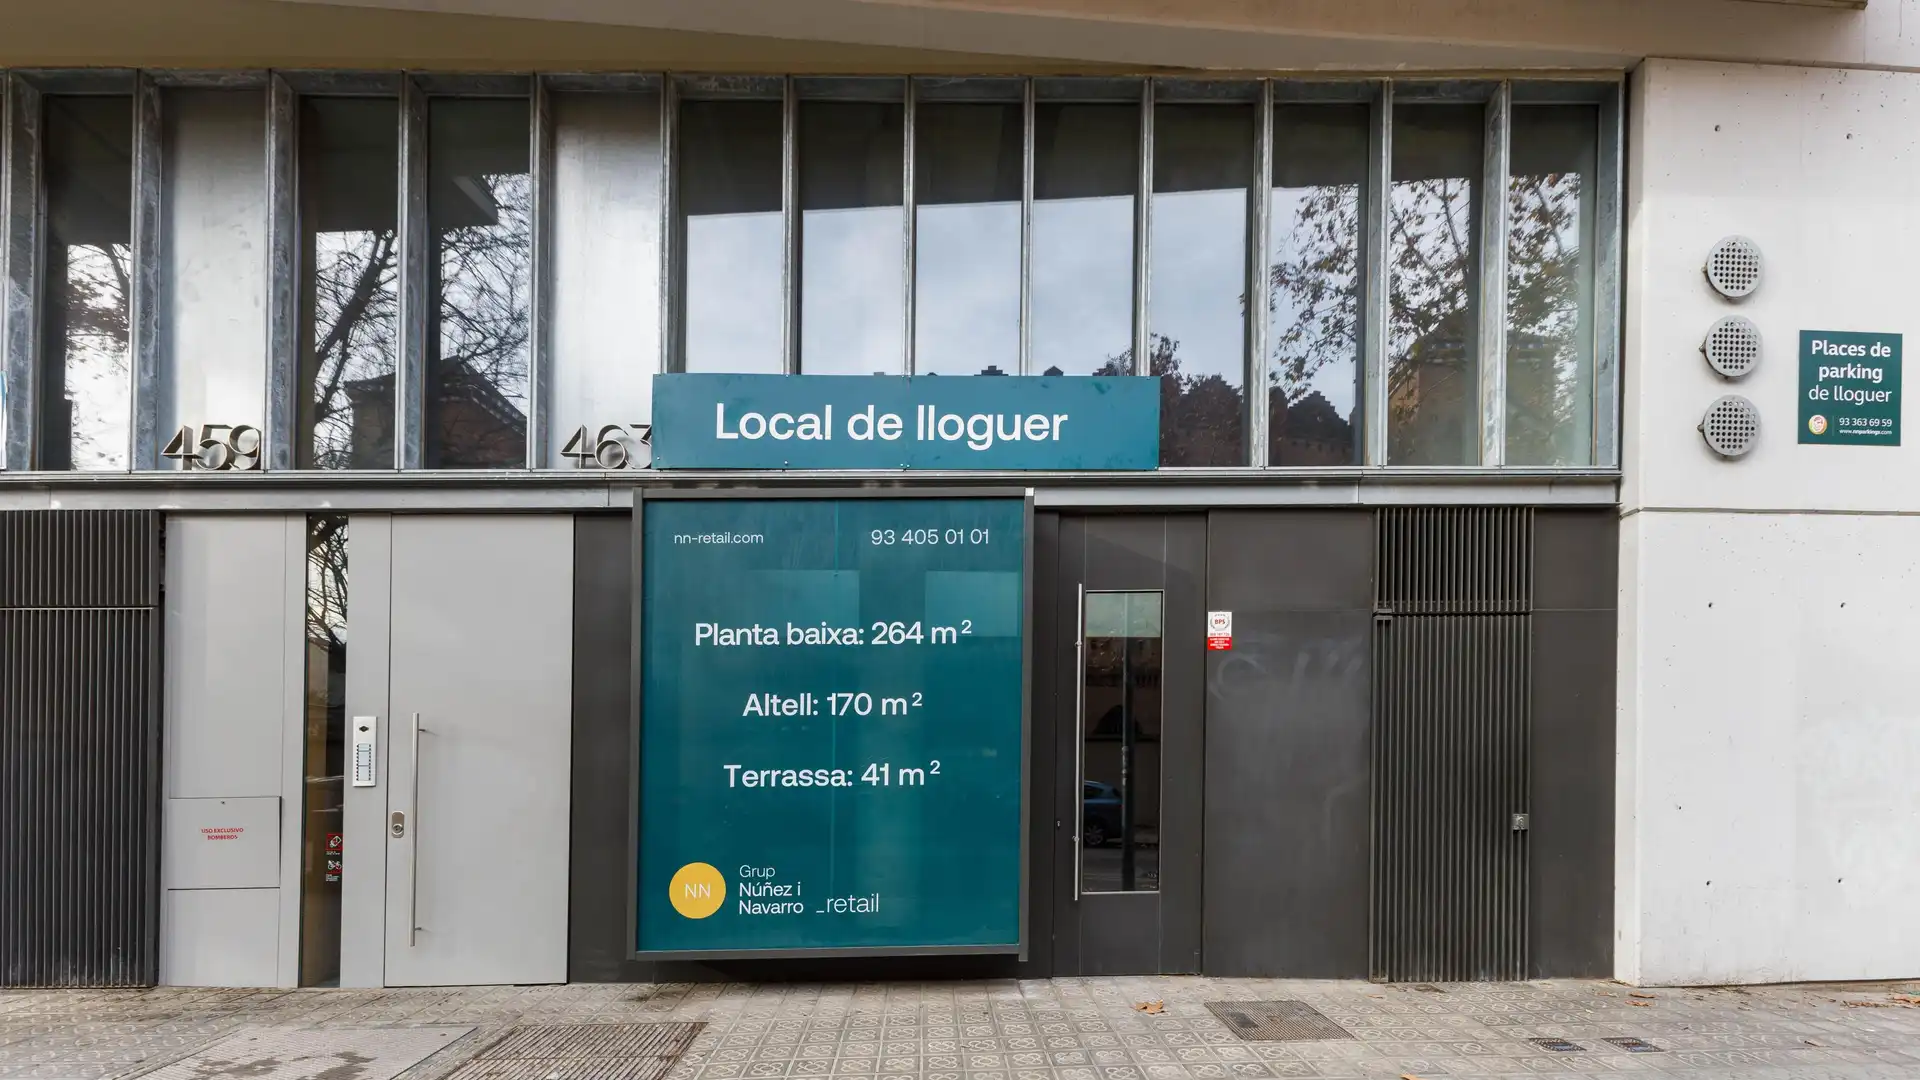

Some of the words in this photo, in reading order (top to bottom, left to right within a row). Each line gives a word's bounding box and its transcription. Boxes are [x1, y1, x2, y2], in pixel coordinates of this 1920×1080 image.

[1811, 339, 1867, 357] Places
[1870, 341, 1892, 358] de
[1818, 362, 1883, 384] parking
[1808, 384, 1830, 401] de
[1833, 385, 1893, 406] lloguer
[715, 402, 833, 441] Local
[847, 404, 904, 441] de
[916, 404, 1069, 452] lloguer
[1838, 418, 1850, 426] 93
[1852, 418, 1868, 426] 363
[1869, 418, 1880, 427] 69
[1881, 418, 1892, 428] 59
[161, 424, 261, 470] 459
[674, 530, 764, 545] nn-retail.com
[870, 529, 896, 546] 93
[901, 528, 939, 545] 405
[944, 528, 964, 545] 01
[969, 528, 989, 545] 01
[695, 622, 780, 647] Planta
[786, 620, 865, 646] baixa:
[871, 620, 925, 645] 264
[741, 692, 819, 717] Altell:
[826, 692, 873, 717] 170
[722, 764, 854, 789] Terrassa:
[860, 762, 890, 787] 41
[739, 864, 776, 880] Grup
[684, 883, 712, 900] NN
[738, 881, 793, 898] Núñez
[797, 881, 802, 898] i
[738, 899, 805, 916] Navarro
